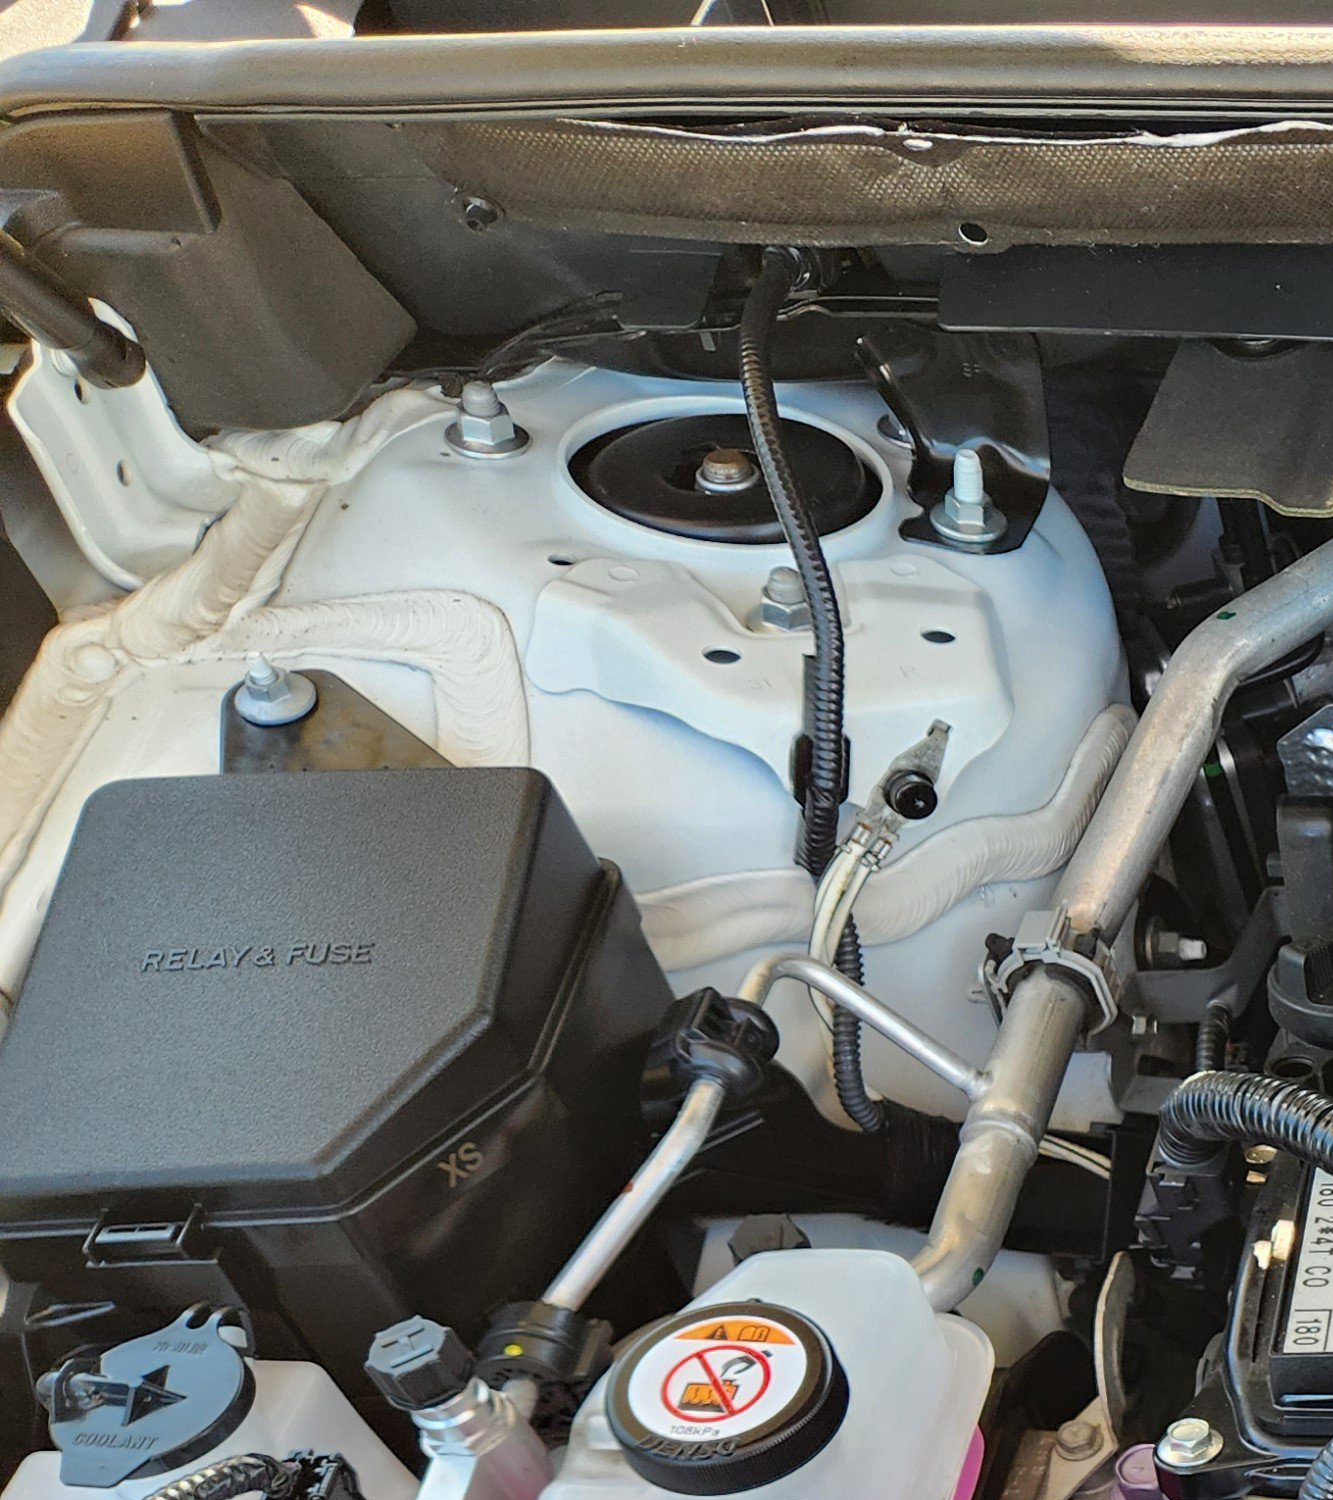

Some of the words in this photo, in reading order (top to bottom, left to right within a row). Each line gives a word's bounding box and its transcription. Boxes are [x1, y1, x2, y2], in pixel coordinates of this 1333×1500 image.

[140, 945, 252, 975] RELAY
[252, 944, 276, 968] &
[285, 941, 376, 967] FUSE
[1292, 1317, 1322, 1346] 180
[71, 1431, 160, 1451] COOLANT
